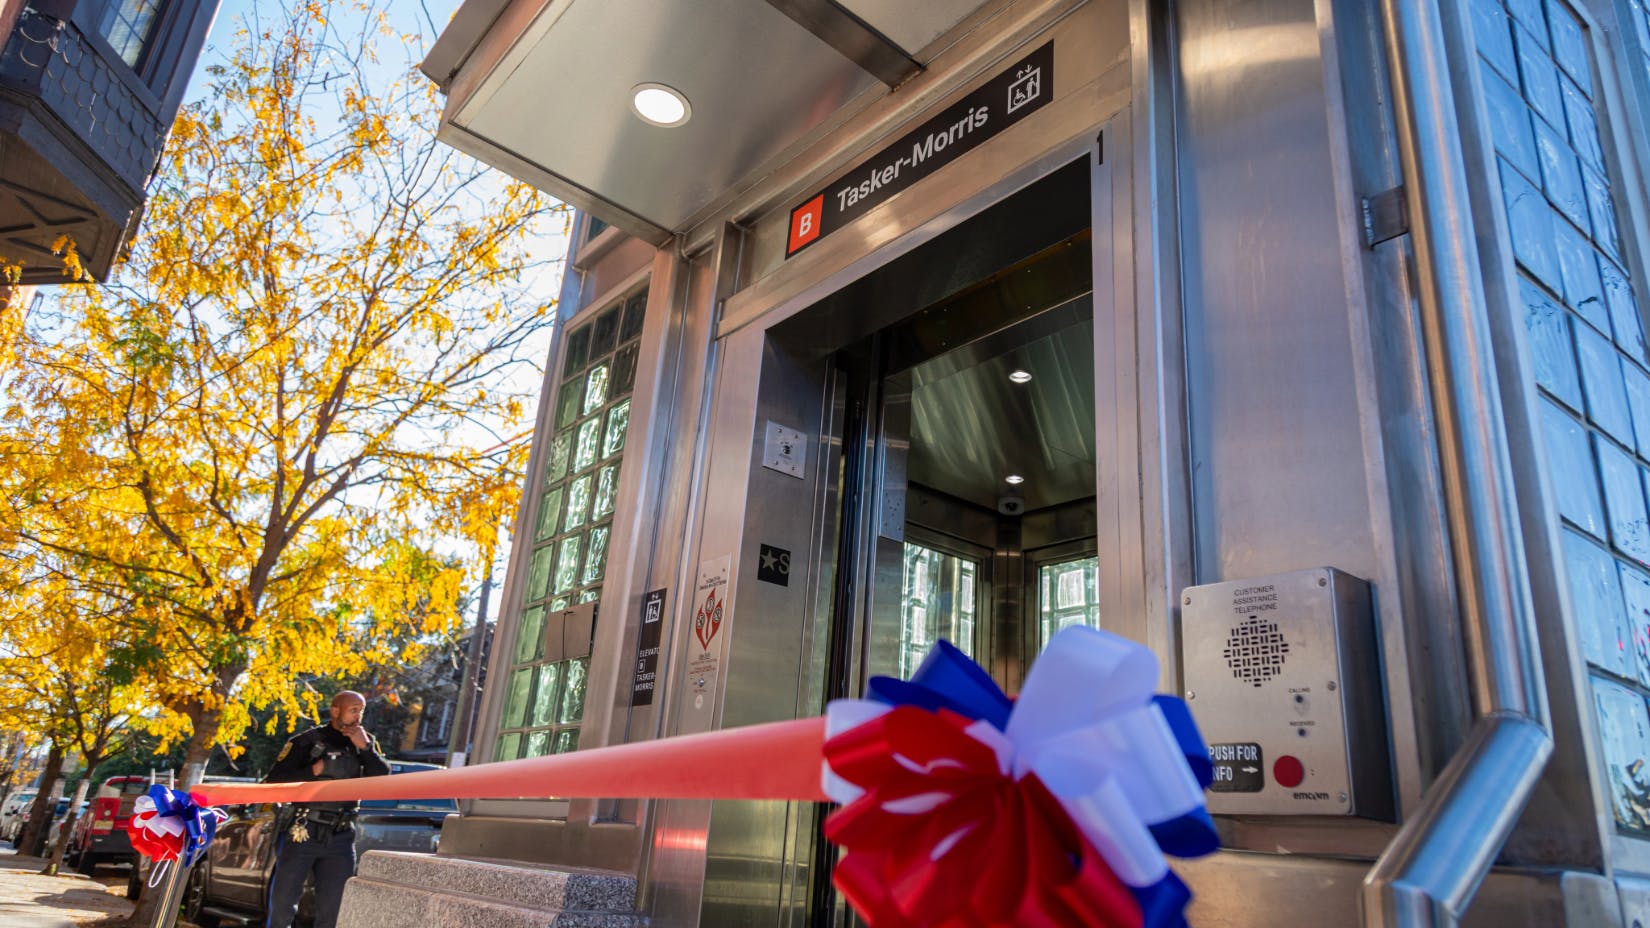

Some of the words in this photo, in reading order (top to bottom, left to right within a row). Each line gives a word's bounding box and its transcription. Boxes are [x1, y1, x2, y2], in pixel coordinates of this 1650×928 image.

[1096, 129, 1104, 166] 1
[799, 213, 812, 238] B
[837, 105, 989, 212] Tasker-Morris
[1233, 584, 1274, 596] CUSTOMER
[1233, 593, 1278, 605] ASSISTANCE
[1233, 602, 1278, 613] TELEPHONE
[635, 681, 654, 691] MORRIS
[1209, 745, 1235, 761] PUSH
[1236, 744, 1258, 761] FOR
[1212, 765, 1233, 782] NFO
